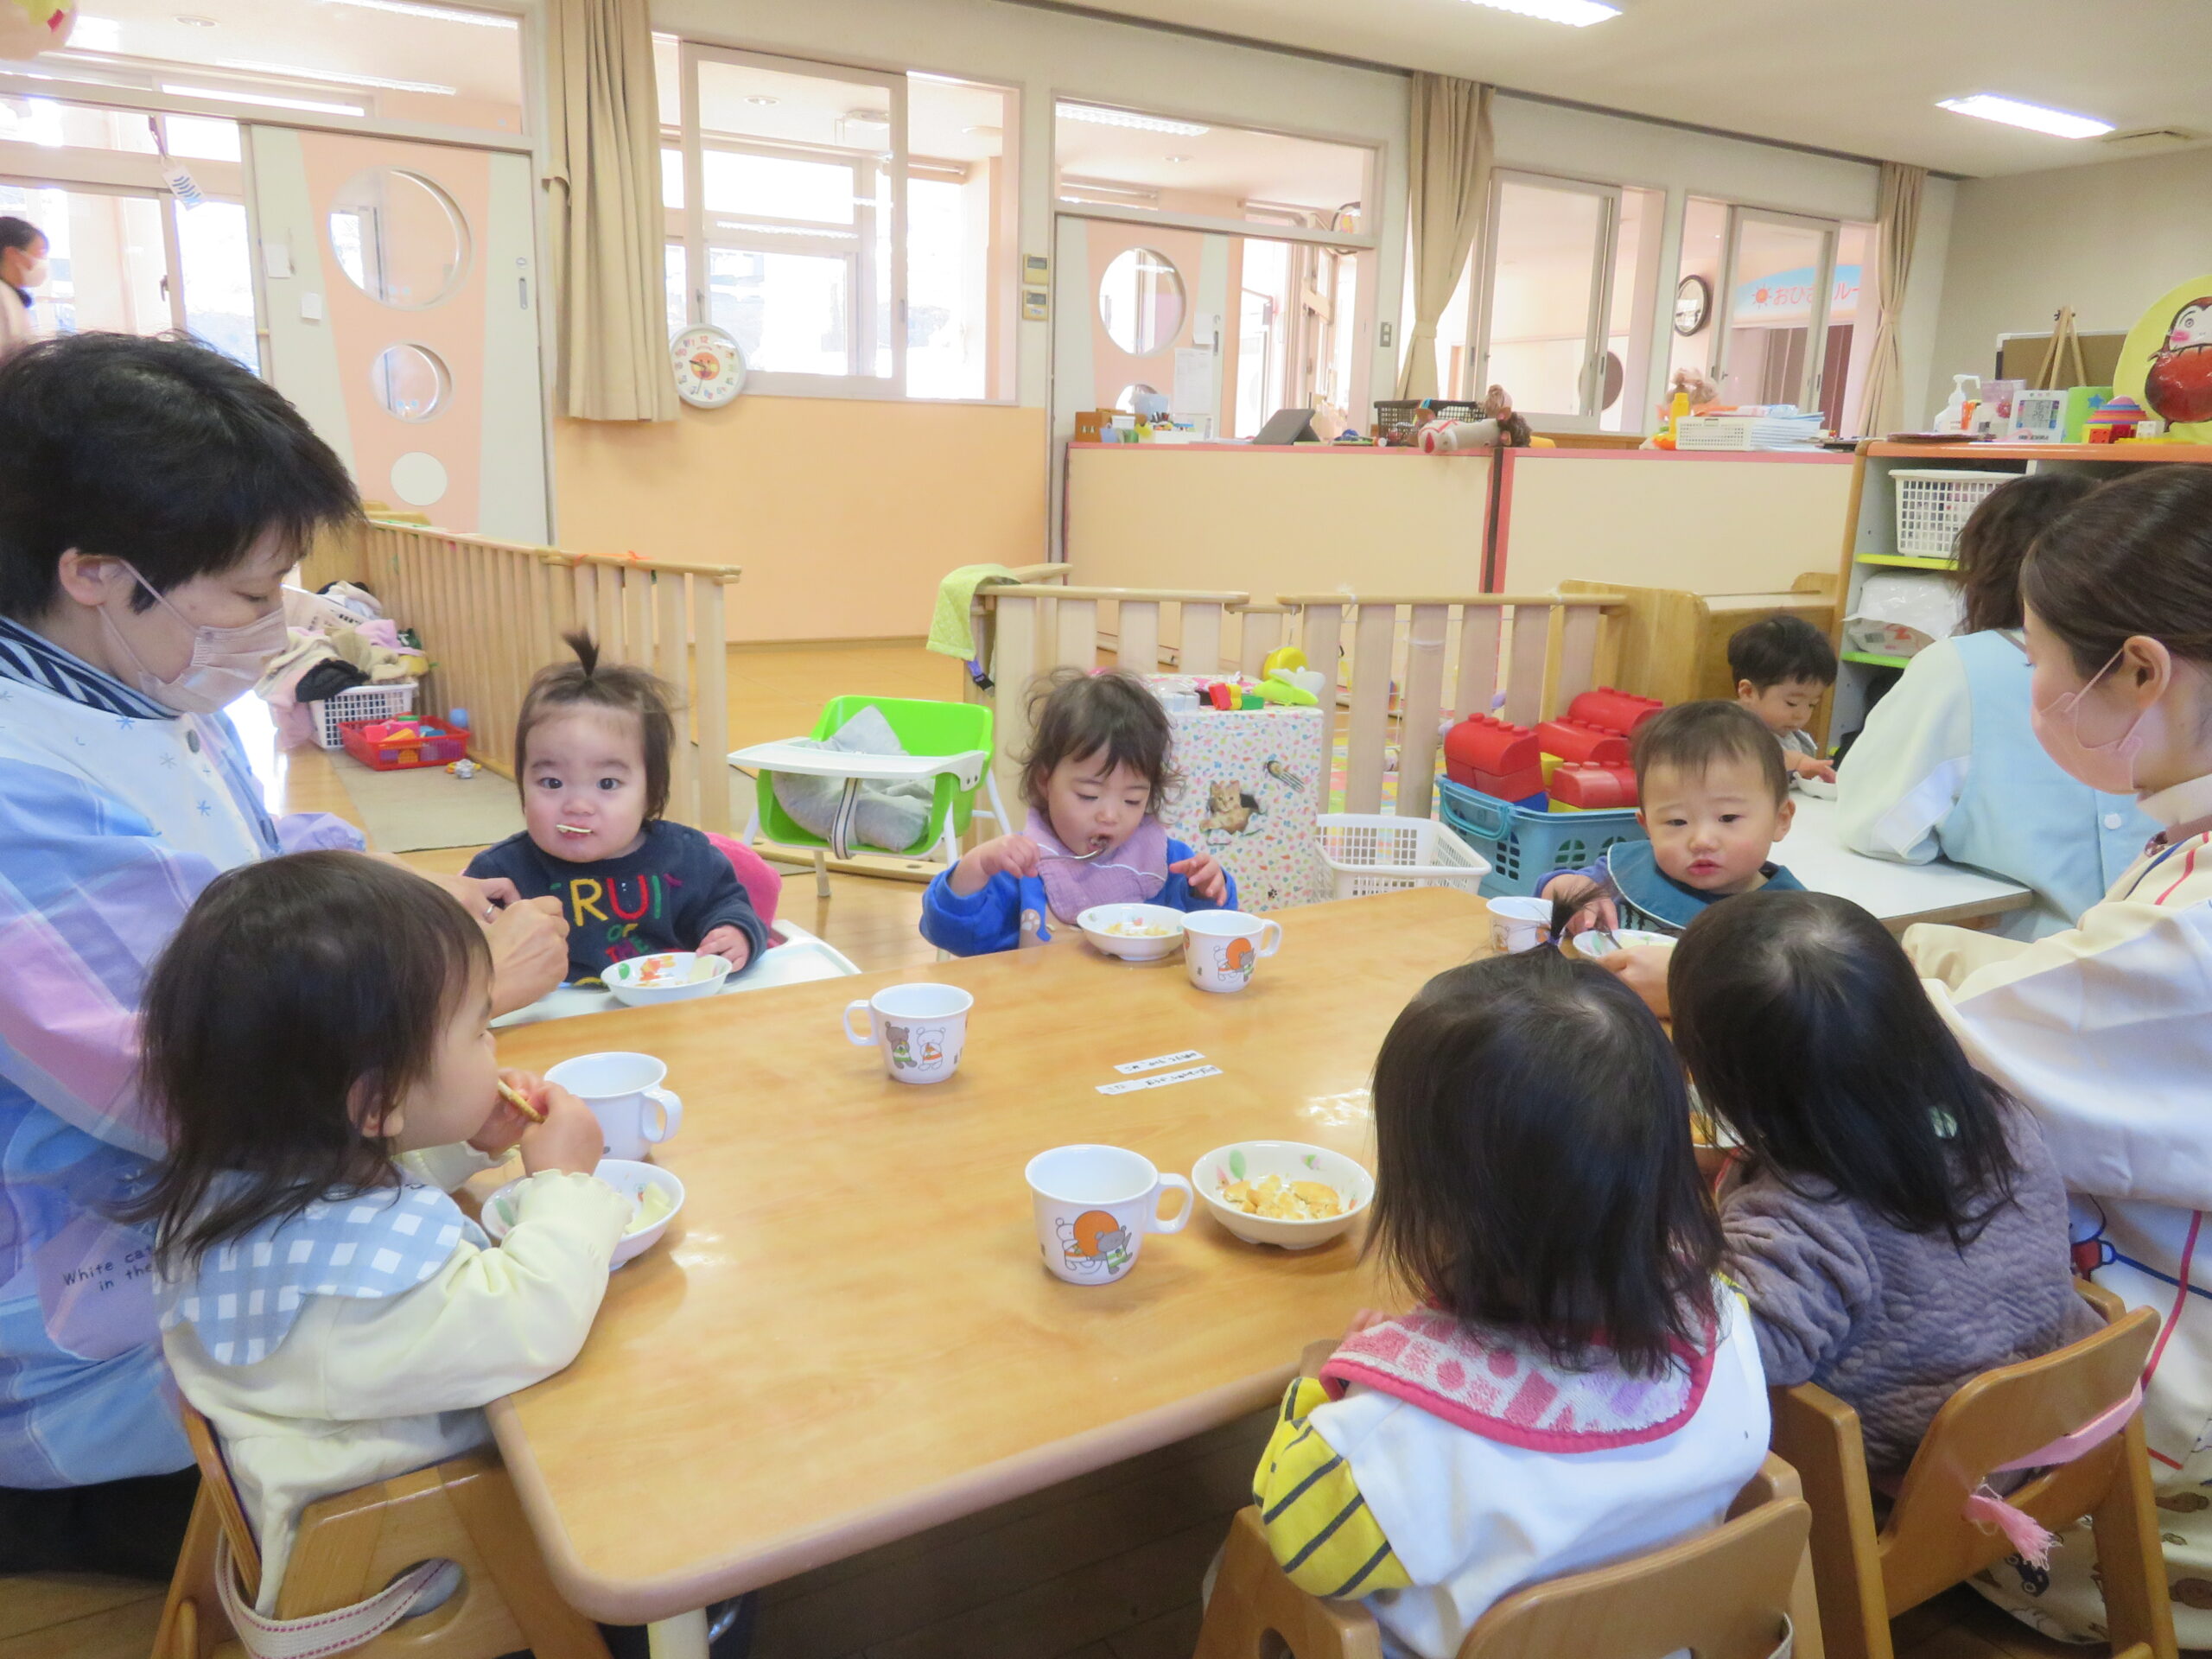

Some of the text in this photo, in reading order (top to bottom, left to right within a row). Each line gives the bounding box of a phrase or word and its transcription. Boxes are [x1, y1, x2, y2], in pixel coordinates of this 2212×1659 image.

[1772, 282, 1861, 305] おひさルー
[550, 874, 683, 927] RUI
[62, 1261, 114, 1286] White
[99, 1280, 114, 1291] in
